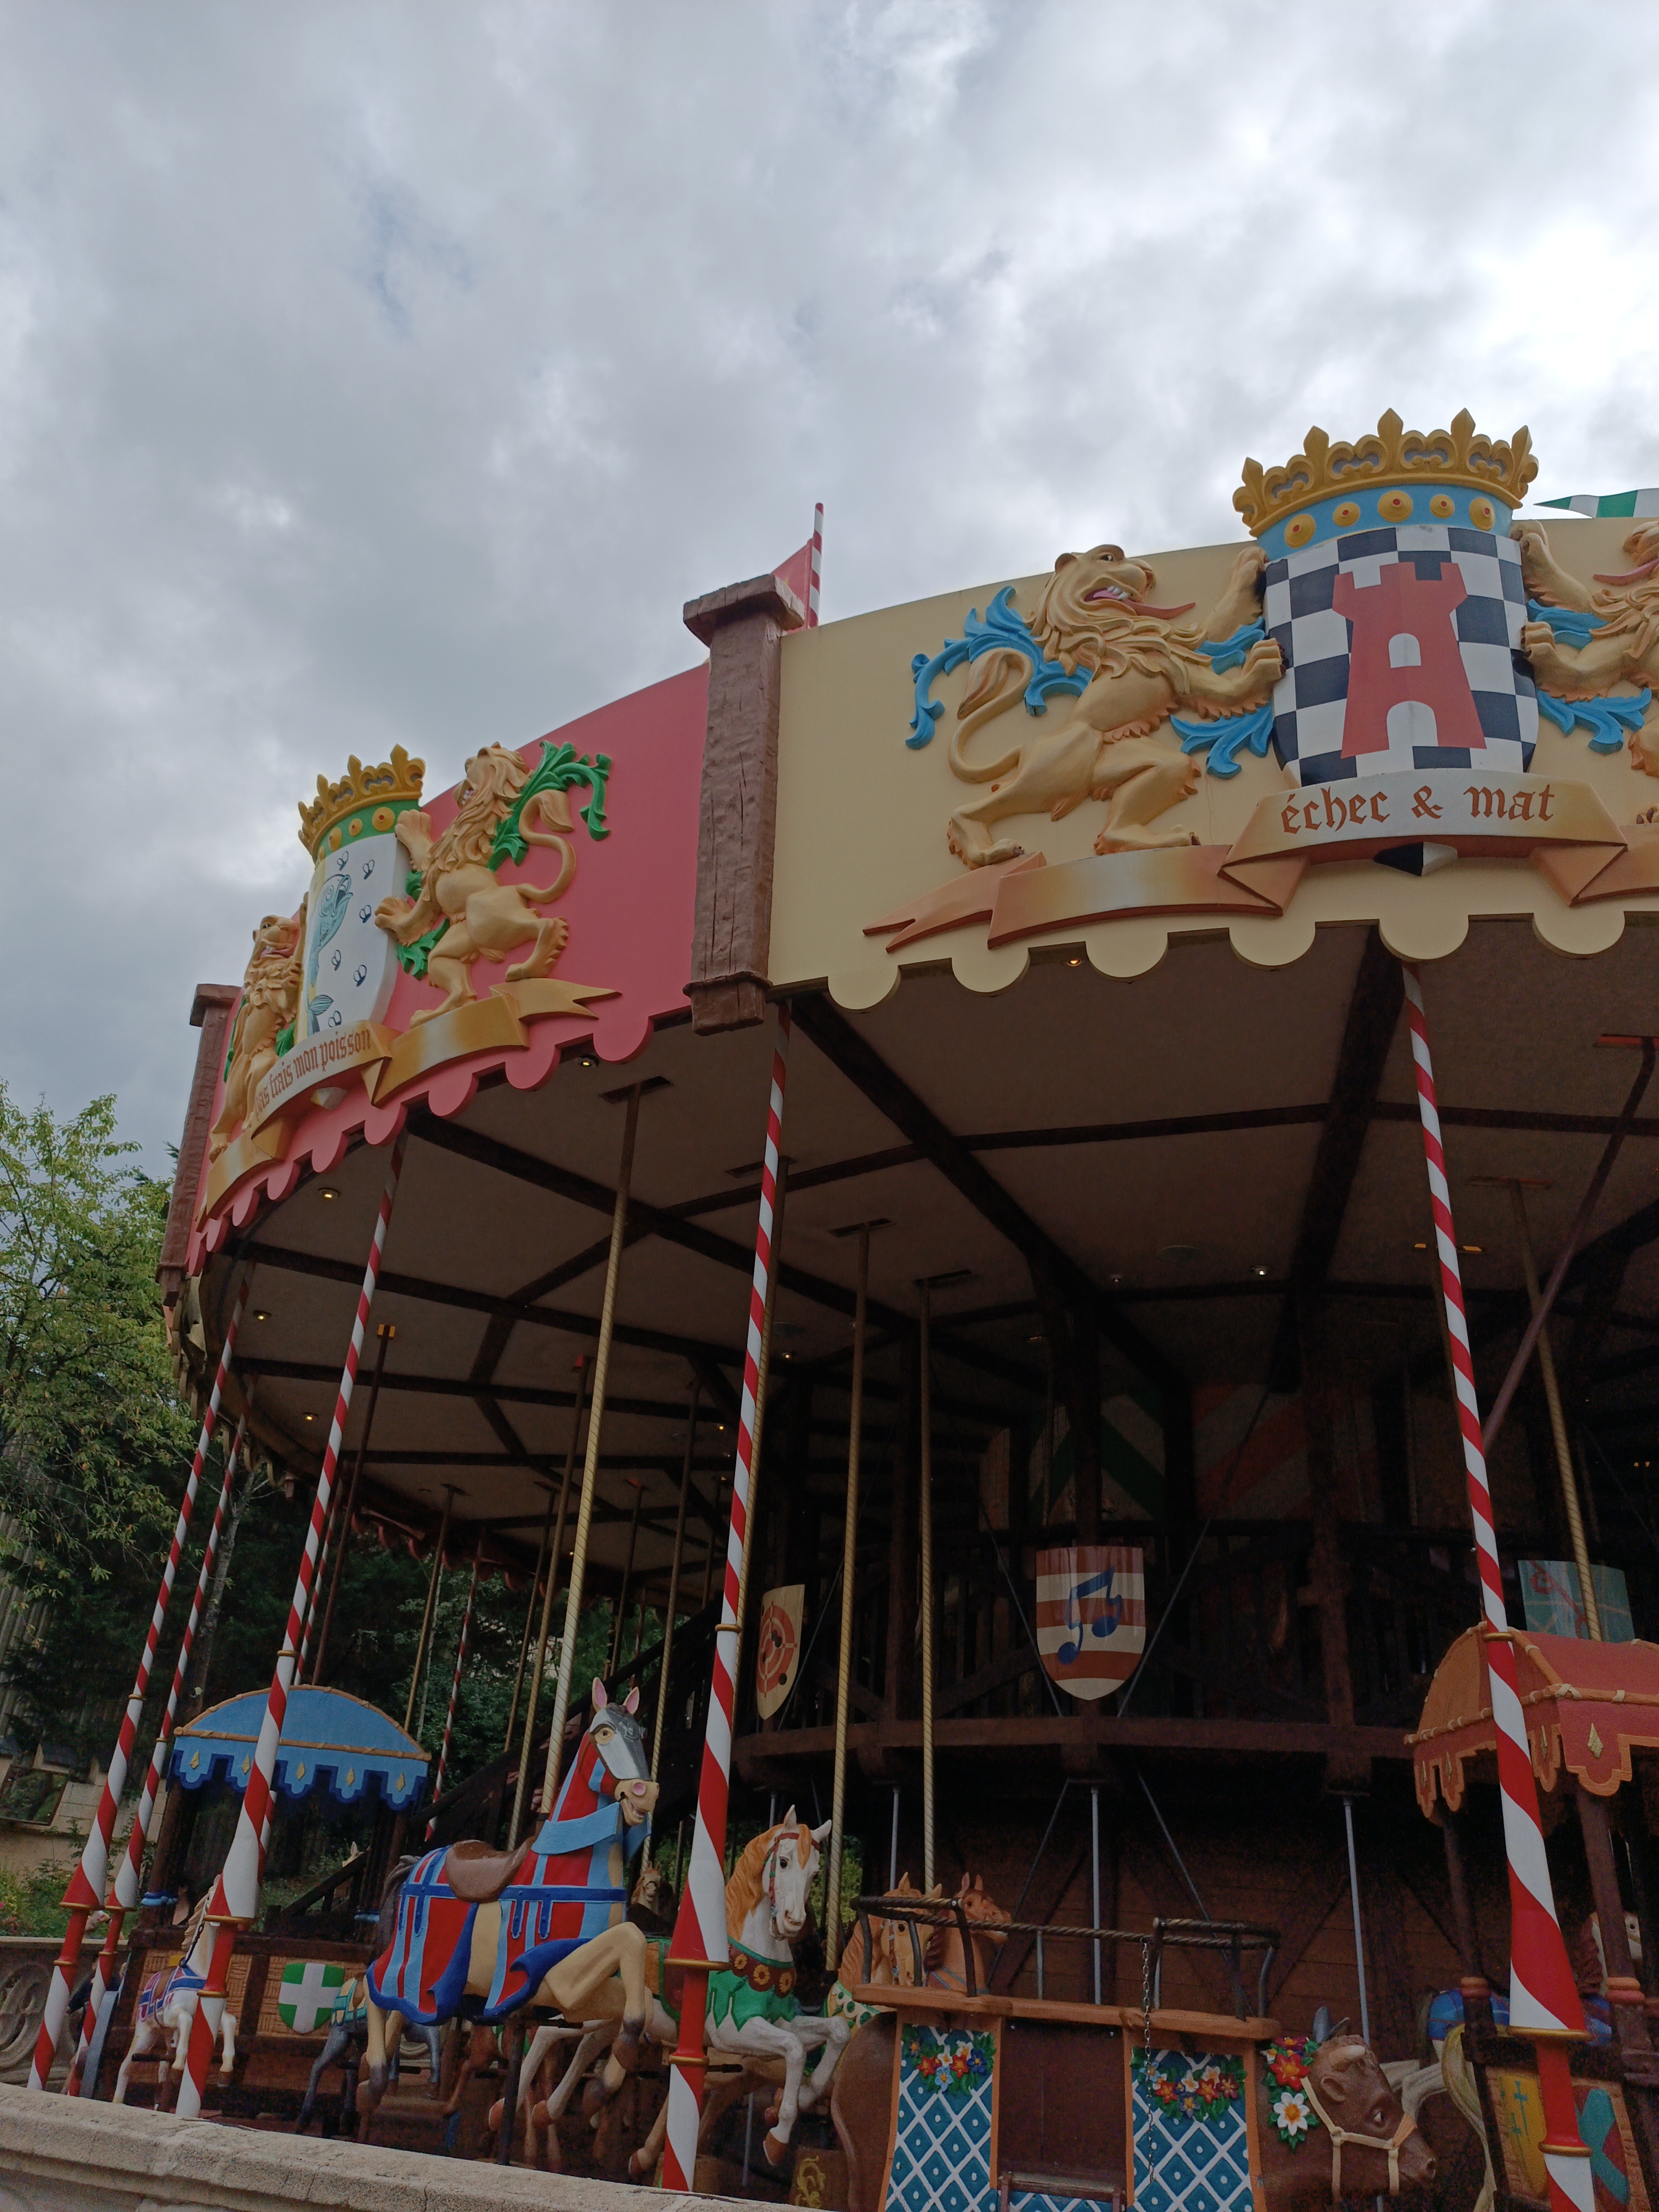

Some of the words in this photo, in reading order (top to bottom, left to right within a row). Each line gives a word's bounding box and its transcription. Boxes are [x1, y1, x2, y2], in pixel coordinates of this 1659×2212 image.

[1280, 786, 1390, 834] échec
[1411, 785, 1444, 819] &
[1463, 783, 1555, 822] mat
[254, 1082, 270, 1122] pas
[269, 1061, 294, 1099] frais
[293, 1046, 319, 1079] mon
[319, 1029, 371, 1072] poisson
